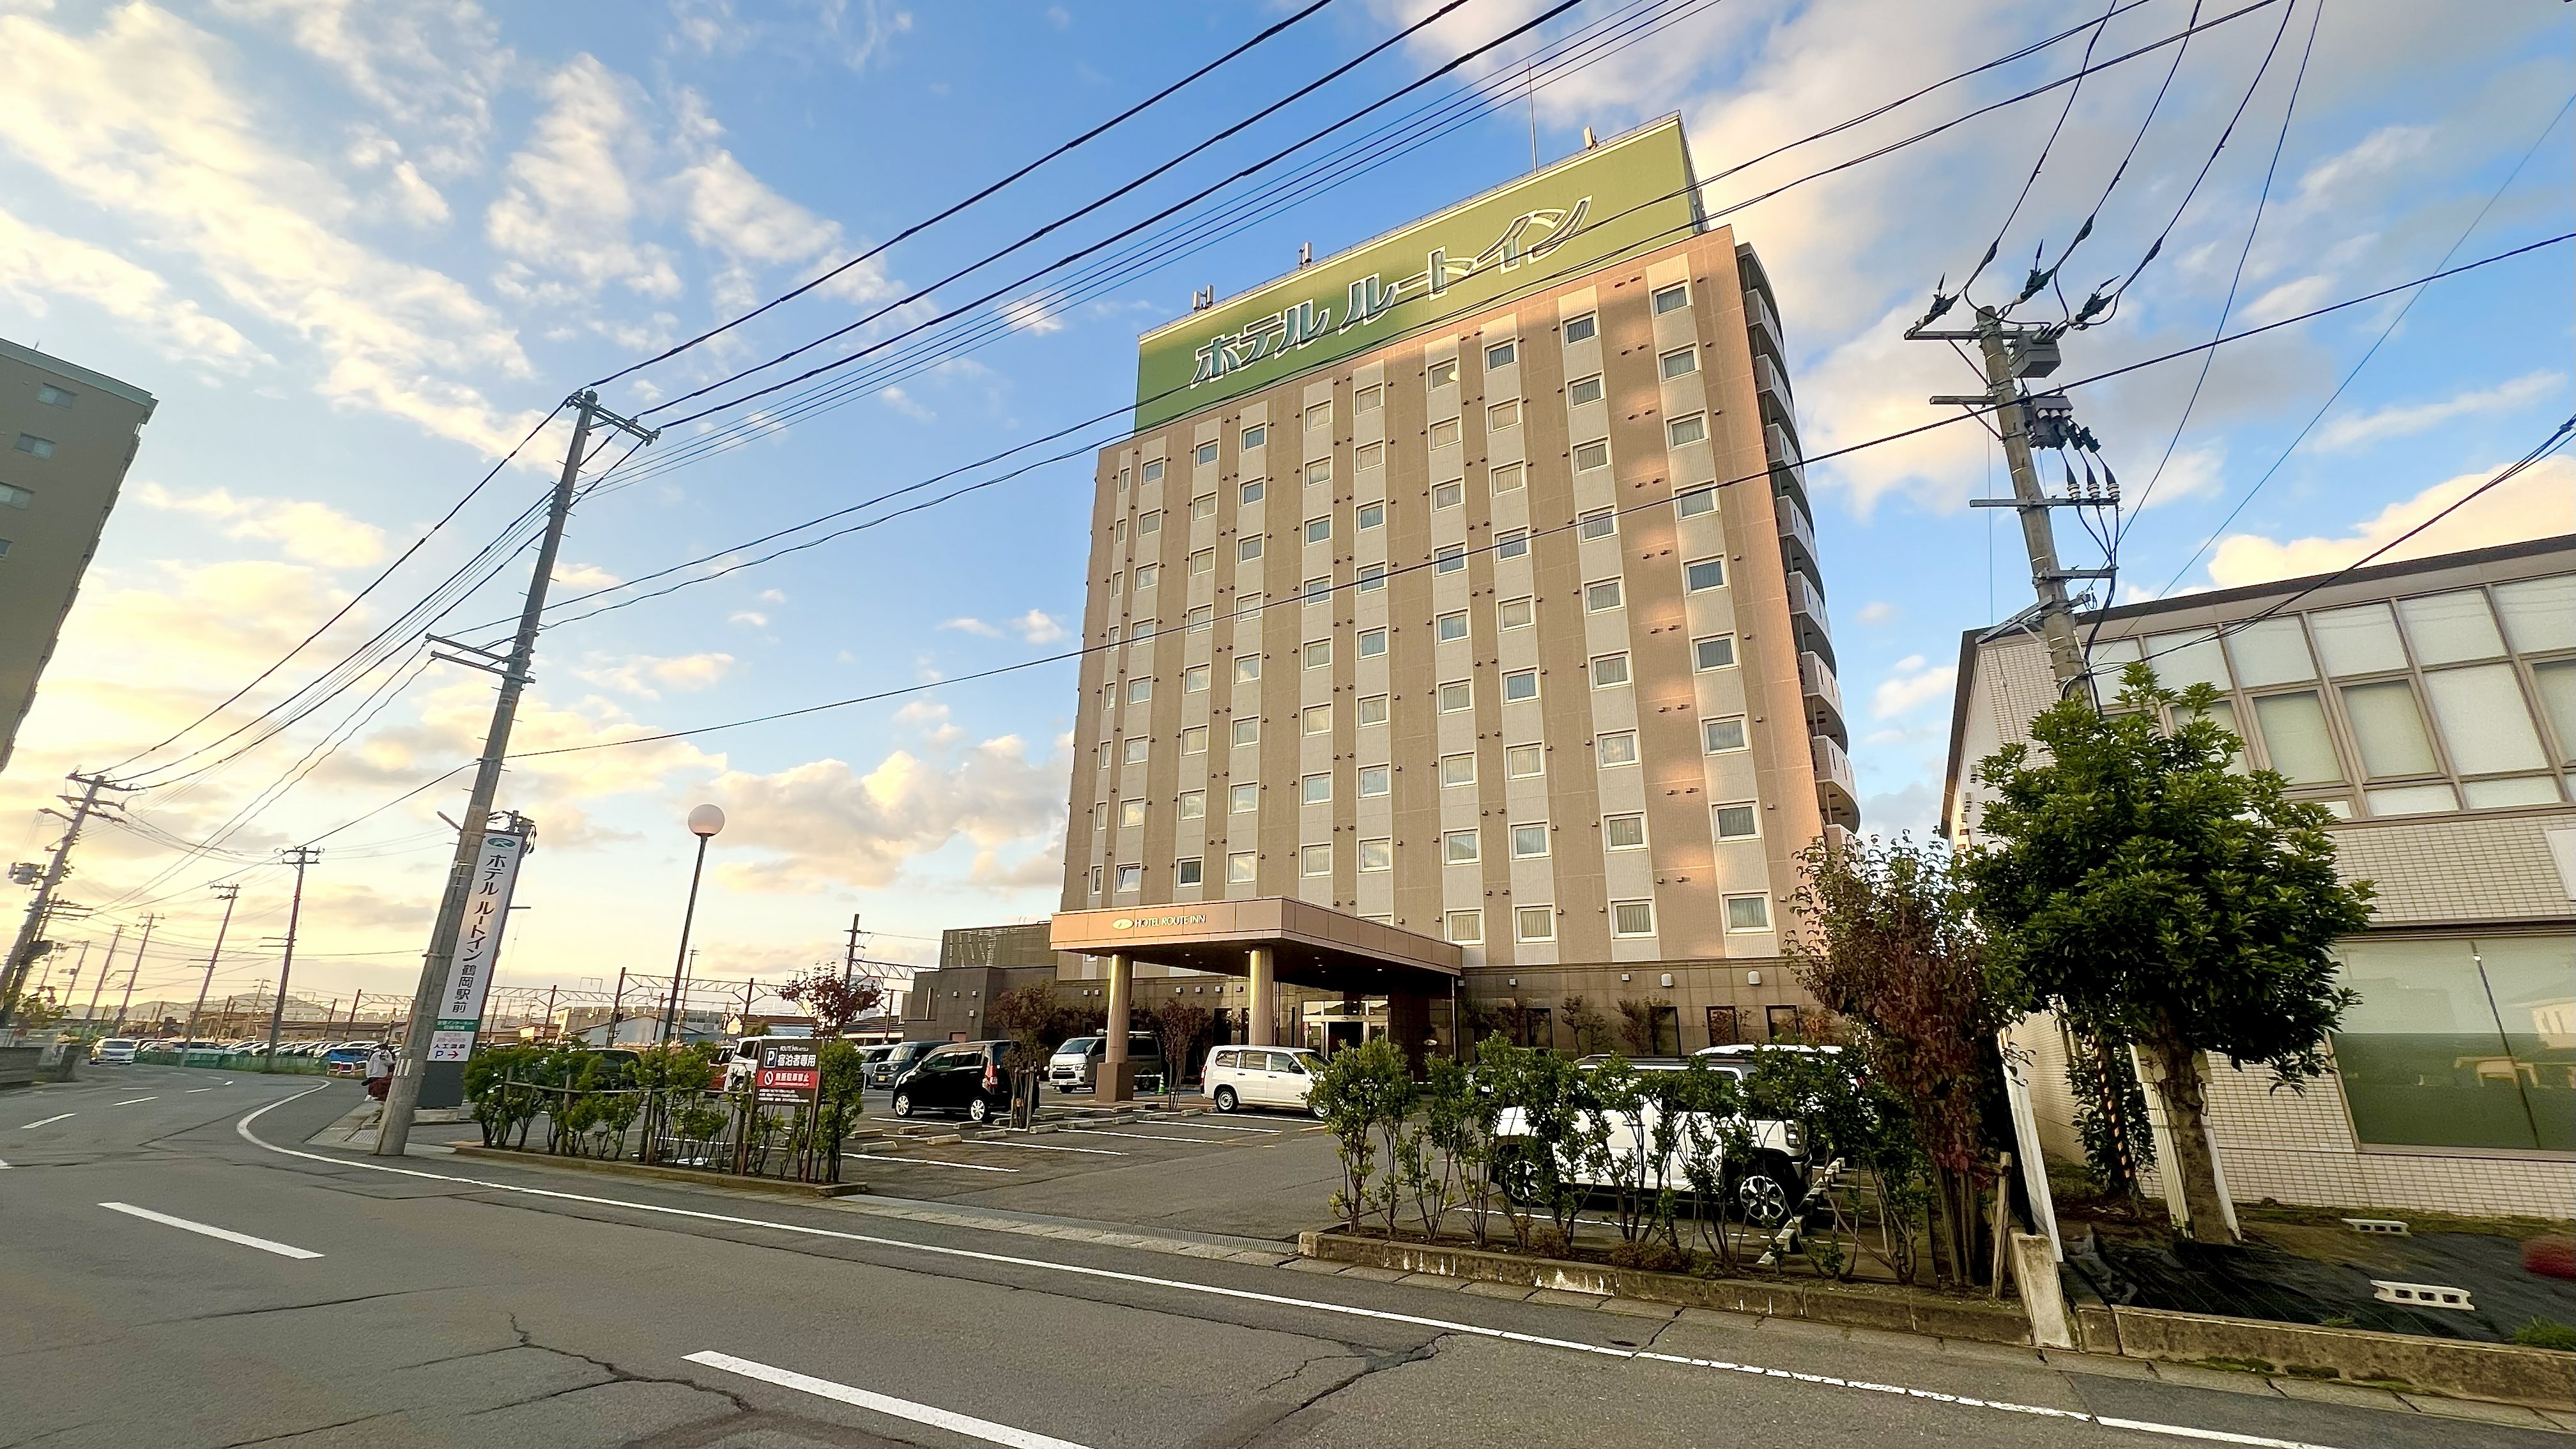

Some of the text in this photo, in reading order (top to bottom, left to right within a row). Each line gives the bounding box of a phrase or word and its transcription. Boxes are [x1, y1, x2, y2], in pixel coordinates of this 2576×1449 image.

[1190, 194, 1593, 390] ホテル ルートイン
[479, 854, 507, 896] ホテル
[1135, 914, 1206, 927] HOTEL ROUTE INN
[435, 1050, 443, 1059] P
[767, 1051, 774, 1065] P
[778, 1054, 816, 1066] 宿泊者専用
